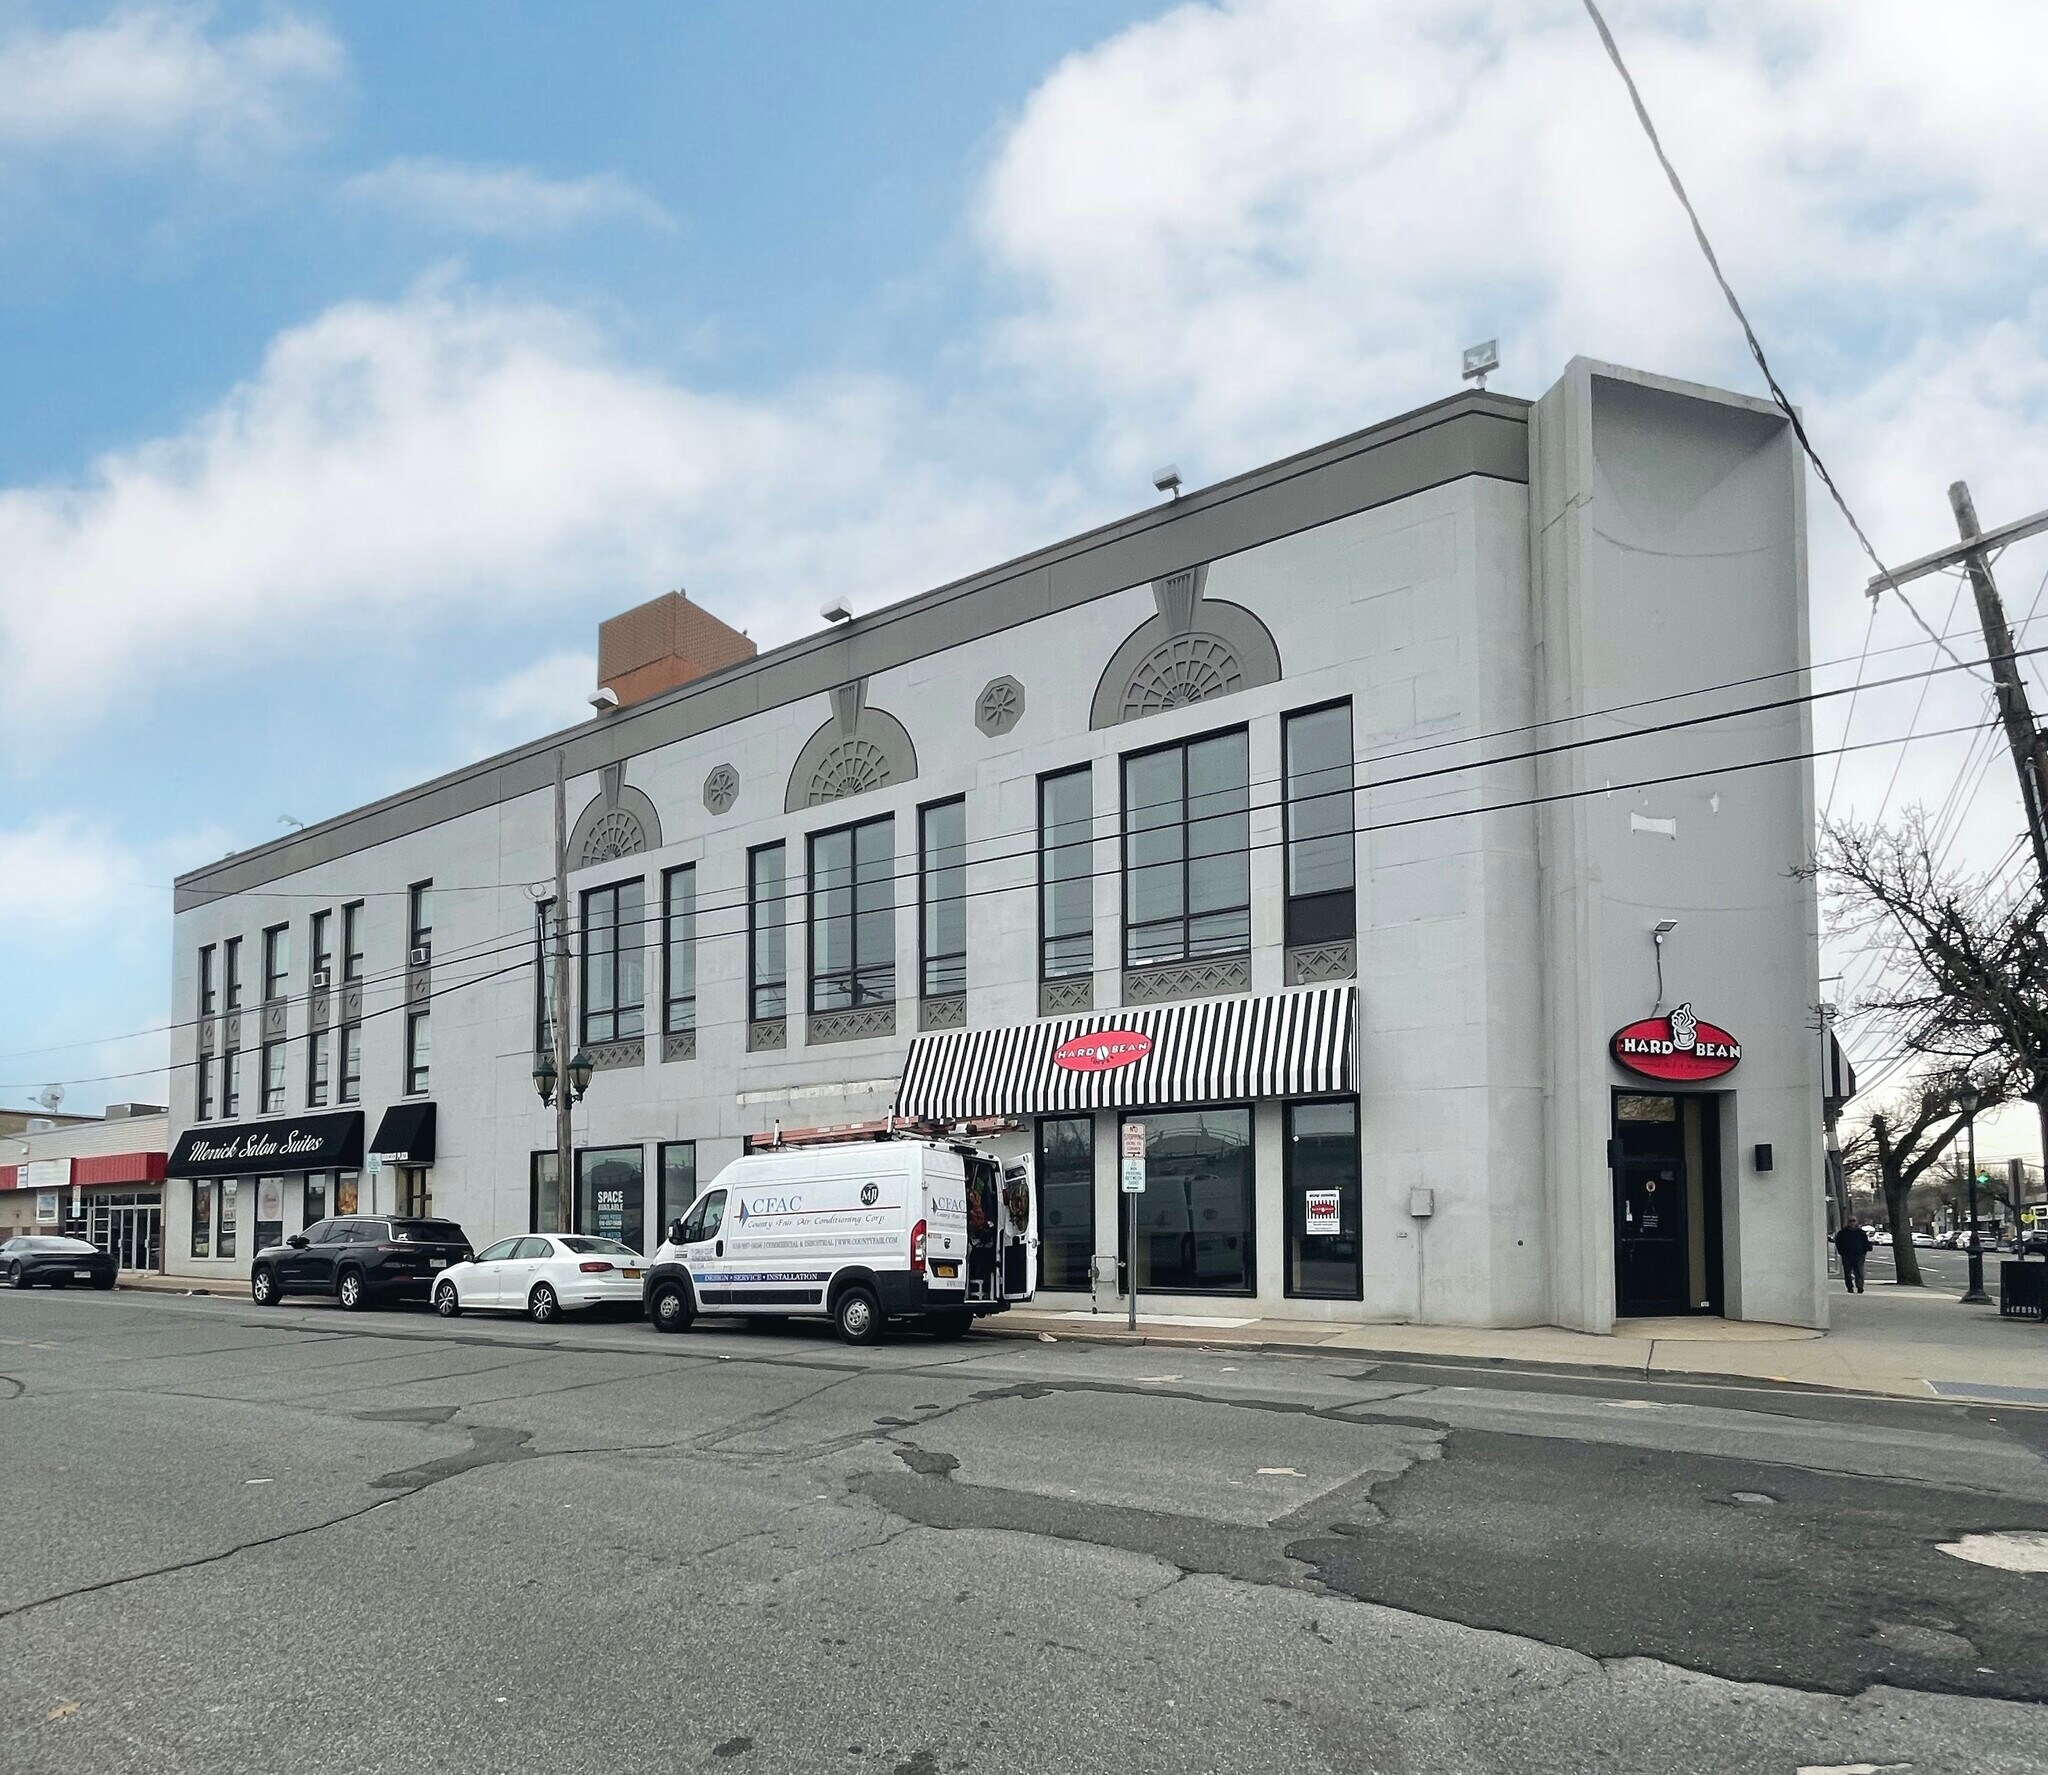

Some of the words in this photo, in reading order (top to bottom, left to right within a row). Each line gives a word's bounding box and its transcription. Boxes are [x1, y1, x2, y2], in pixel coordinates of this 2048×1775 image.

[1057, 1047, 1095, 1059] HARD
[1111, 1042, 1148, 1054] BEAN
[1624, 1038, 1674, 1055] HARD
[1695, 1043, 1741, 1058] BEAN
[188, 1136, 240, 1162] Merrick
[238, 1133, 278, 1158] Salon
[279, 1129, 324, 1155] Suites
[597, 1190, 624, 1204] SPACE
[752, 1195, 802, 1214] CFAC
[938, 1196, 966, 1211] CFAC
[813, 1213, 862, 1226] Conditioning
[704, 1273, 729, 1282] DESIGN
[733, 1273, 762, 1282] SERVICE
[766, 1272, 818, 1281] INSTALLATION
